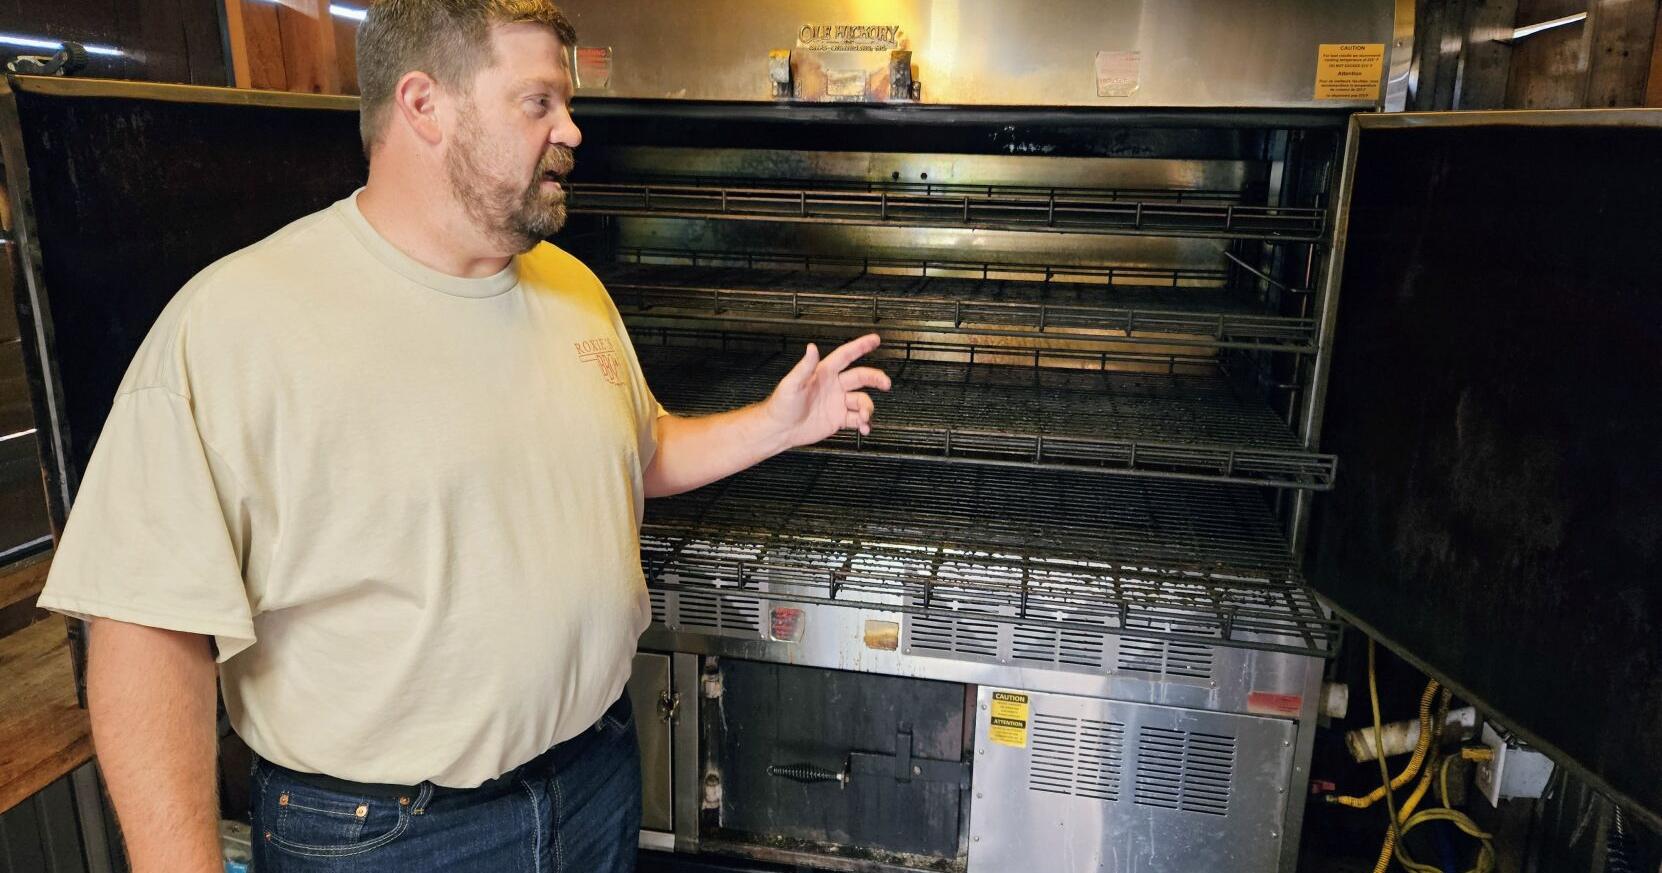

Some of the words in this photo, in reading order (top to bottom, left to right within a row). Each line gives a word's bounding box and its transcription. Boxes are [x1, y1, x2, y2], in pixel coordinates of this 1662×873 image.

[799, 25, 831, 43] OLE
[835, 25, 900, 44] HICKORY
[574, 337, 615, 354] ROXIE'S
[995, 693, 1025, 703] CAUTION
[993, 719, 1024, 728] ATTENTION
